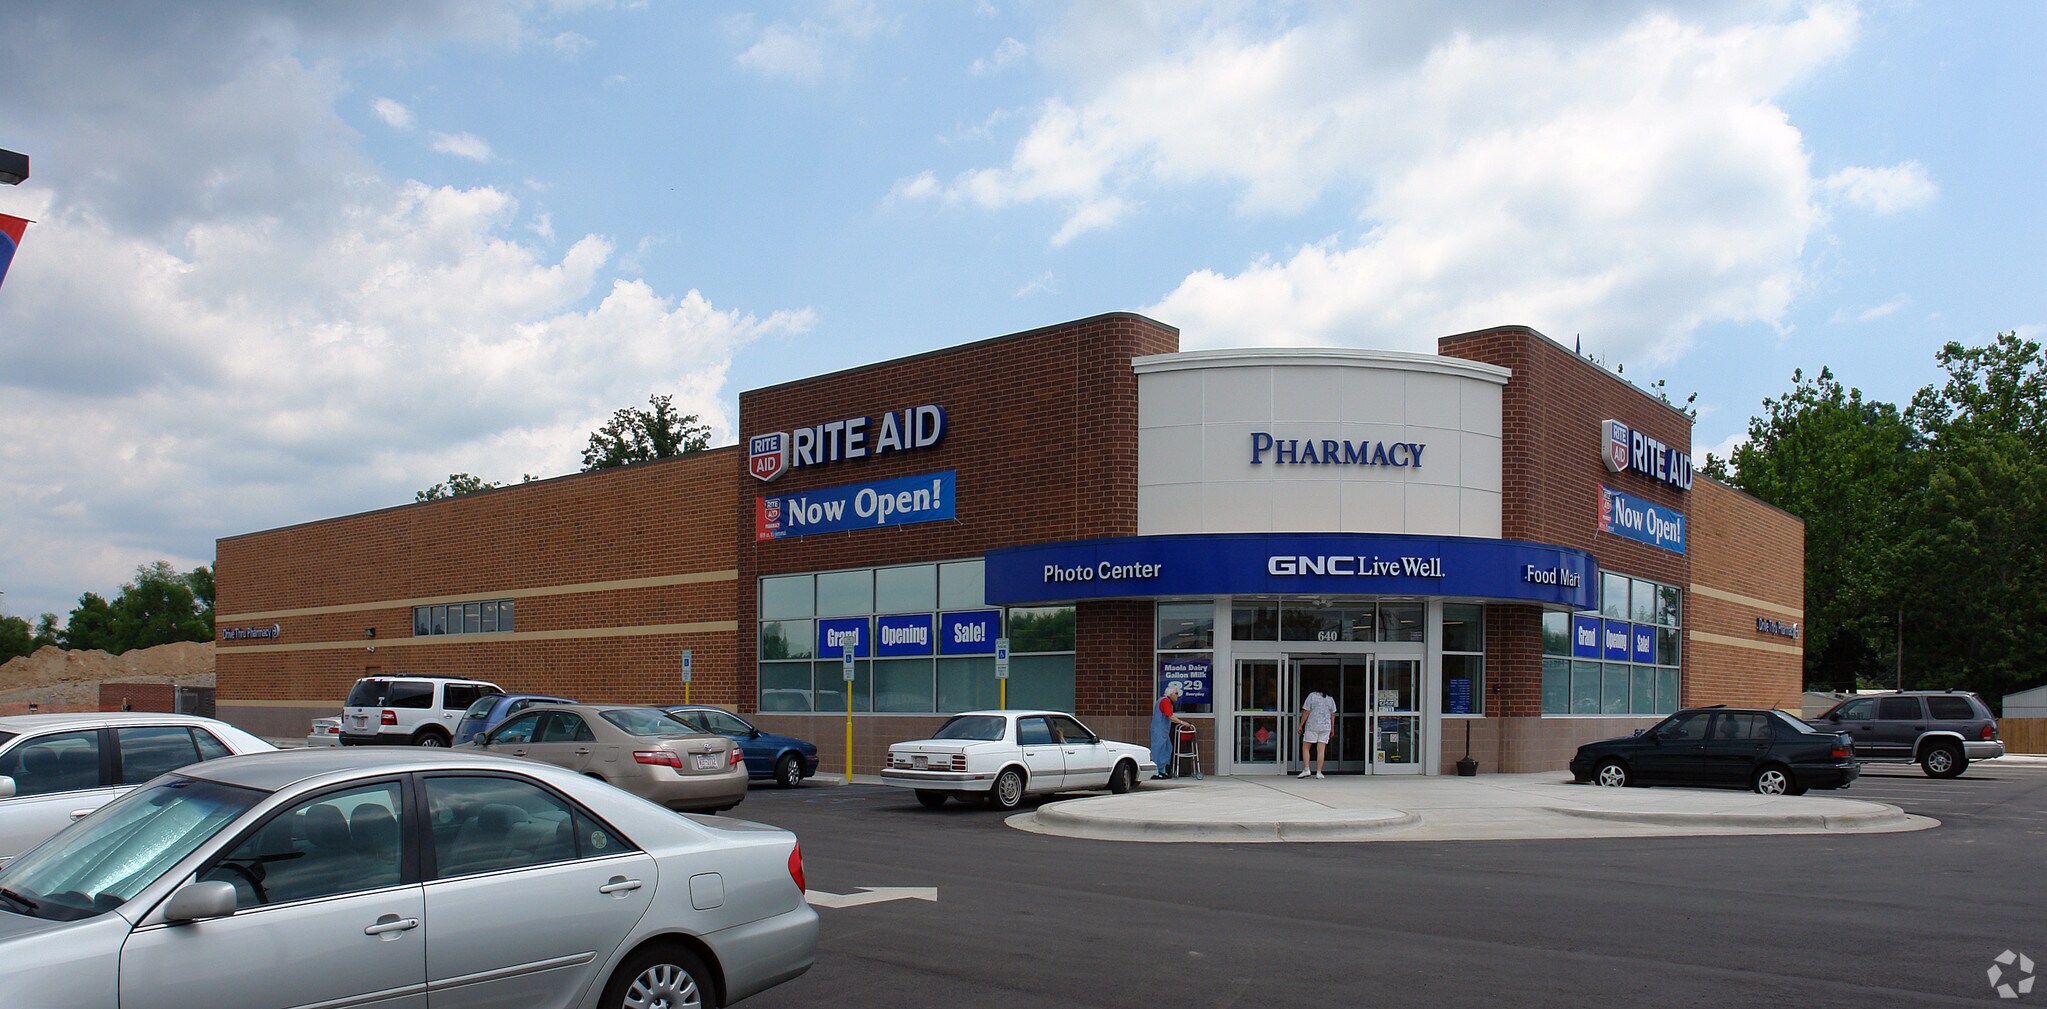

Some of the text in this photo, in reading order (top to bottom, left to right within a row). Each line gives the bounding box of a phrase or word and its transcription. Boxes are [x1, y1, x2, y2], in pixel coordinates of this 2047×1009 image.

[754, 436, 777, 453] RITE
[793, 404, 948, 467] RITE AID
[1613, 425, 1627, 444] RITE
[1614, 446, 1626, 463] AID
[1631, 430, 1693, 491] RITE AID
[756, 457, 776, 473] AID
[766, 501, 779, 509] RITE
[788, 479, 942, 527] Now Open!
[1615, 496, 1681, 544] Now Open!
[1044, 561, 1162, 582] Photo Center
[1268, 556, 1354, 575] GNC
[1357, 556, 1400, 576] Live
[1527, 564, 1580, 588] Food Mart
[827, 627, 859, 647] Grand
[881, 624, 928, 646] Opening
[954, 621, 986, 643] Sale!
[1317, 631, 1338, 642] 640
[1578, 625, 1596, 647] Grand
[1605, 629, 1627, 652] Opening
[1637, 634, 1650, 653] Sale!
[1188, 664, 1208, 672] Dairy
[1190, 671, 1207, 679] Milk
